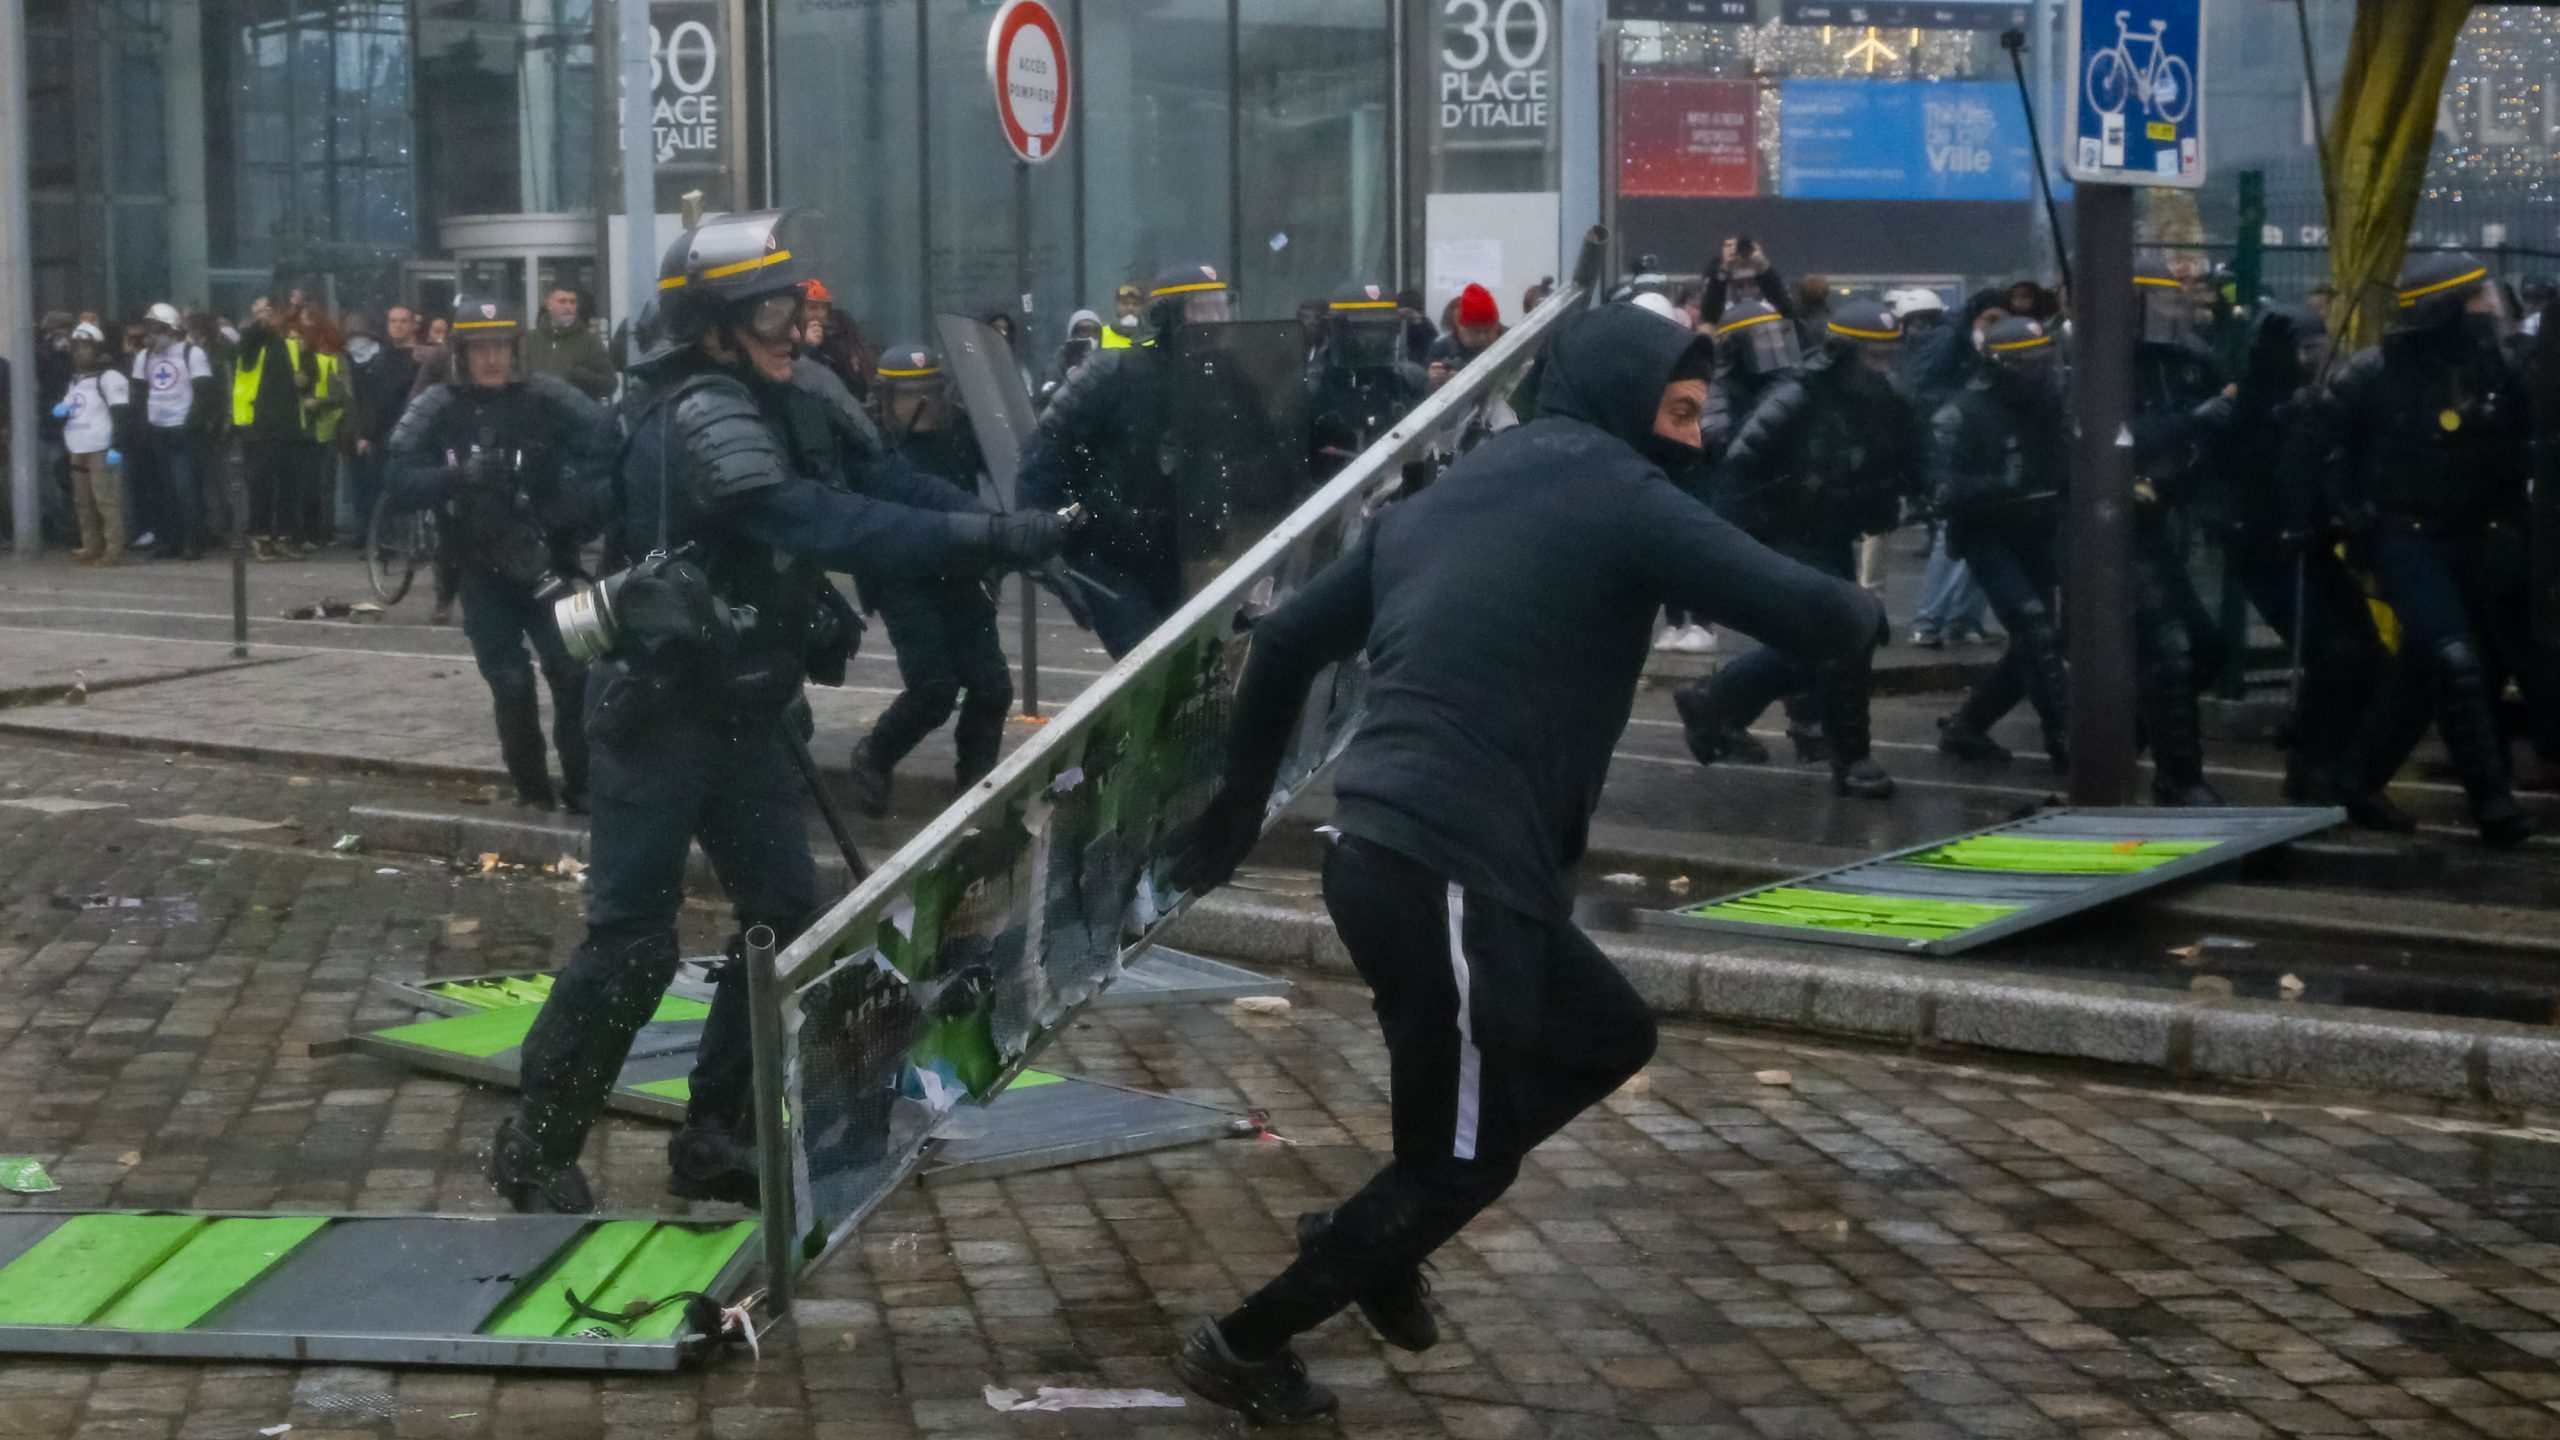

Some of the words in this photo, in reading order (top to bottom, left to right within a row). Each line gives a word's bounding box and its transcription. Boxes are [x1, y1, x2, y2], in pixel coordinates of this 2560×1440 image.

[1442, 0, 1549, 70] 30
[1441, 70, 1549, 102] PLACE
[619, 95, 717, 125] ACE
[1440, 102, 1549, 128] D'ITALIE
